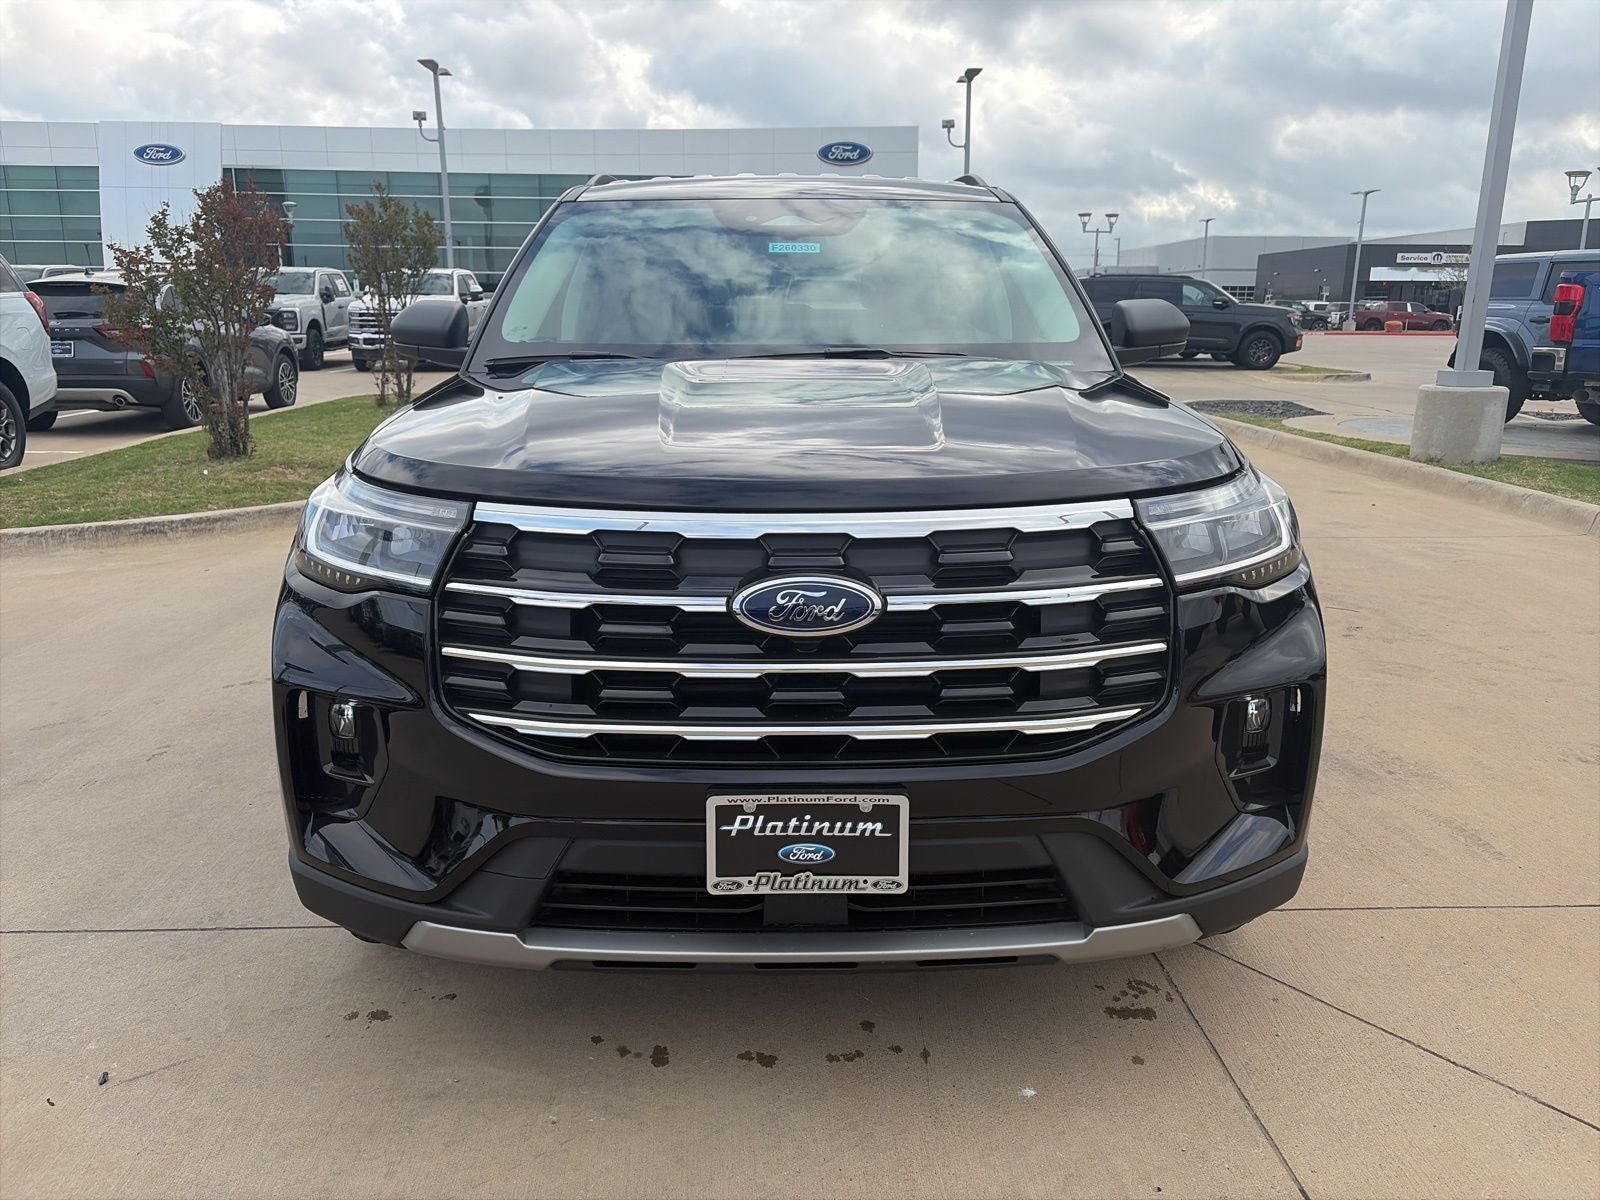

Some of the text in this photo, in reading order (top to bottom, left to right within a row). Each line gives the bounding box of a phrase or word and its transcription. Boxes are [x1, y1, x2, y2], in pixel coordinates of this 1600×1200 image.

[143, 146, 172, 160] Ford
[828, 145, 860, 160] Ford
[768, 589, 847, 622] Ford
[720, 814, 892, 837] Platinum
[789, 847, 825, 861] Ford
[716, 874, 897, 892] Ford Platinum Ford
